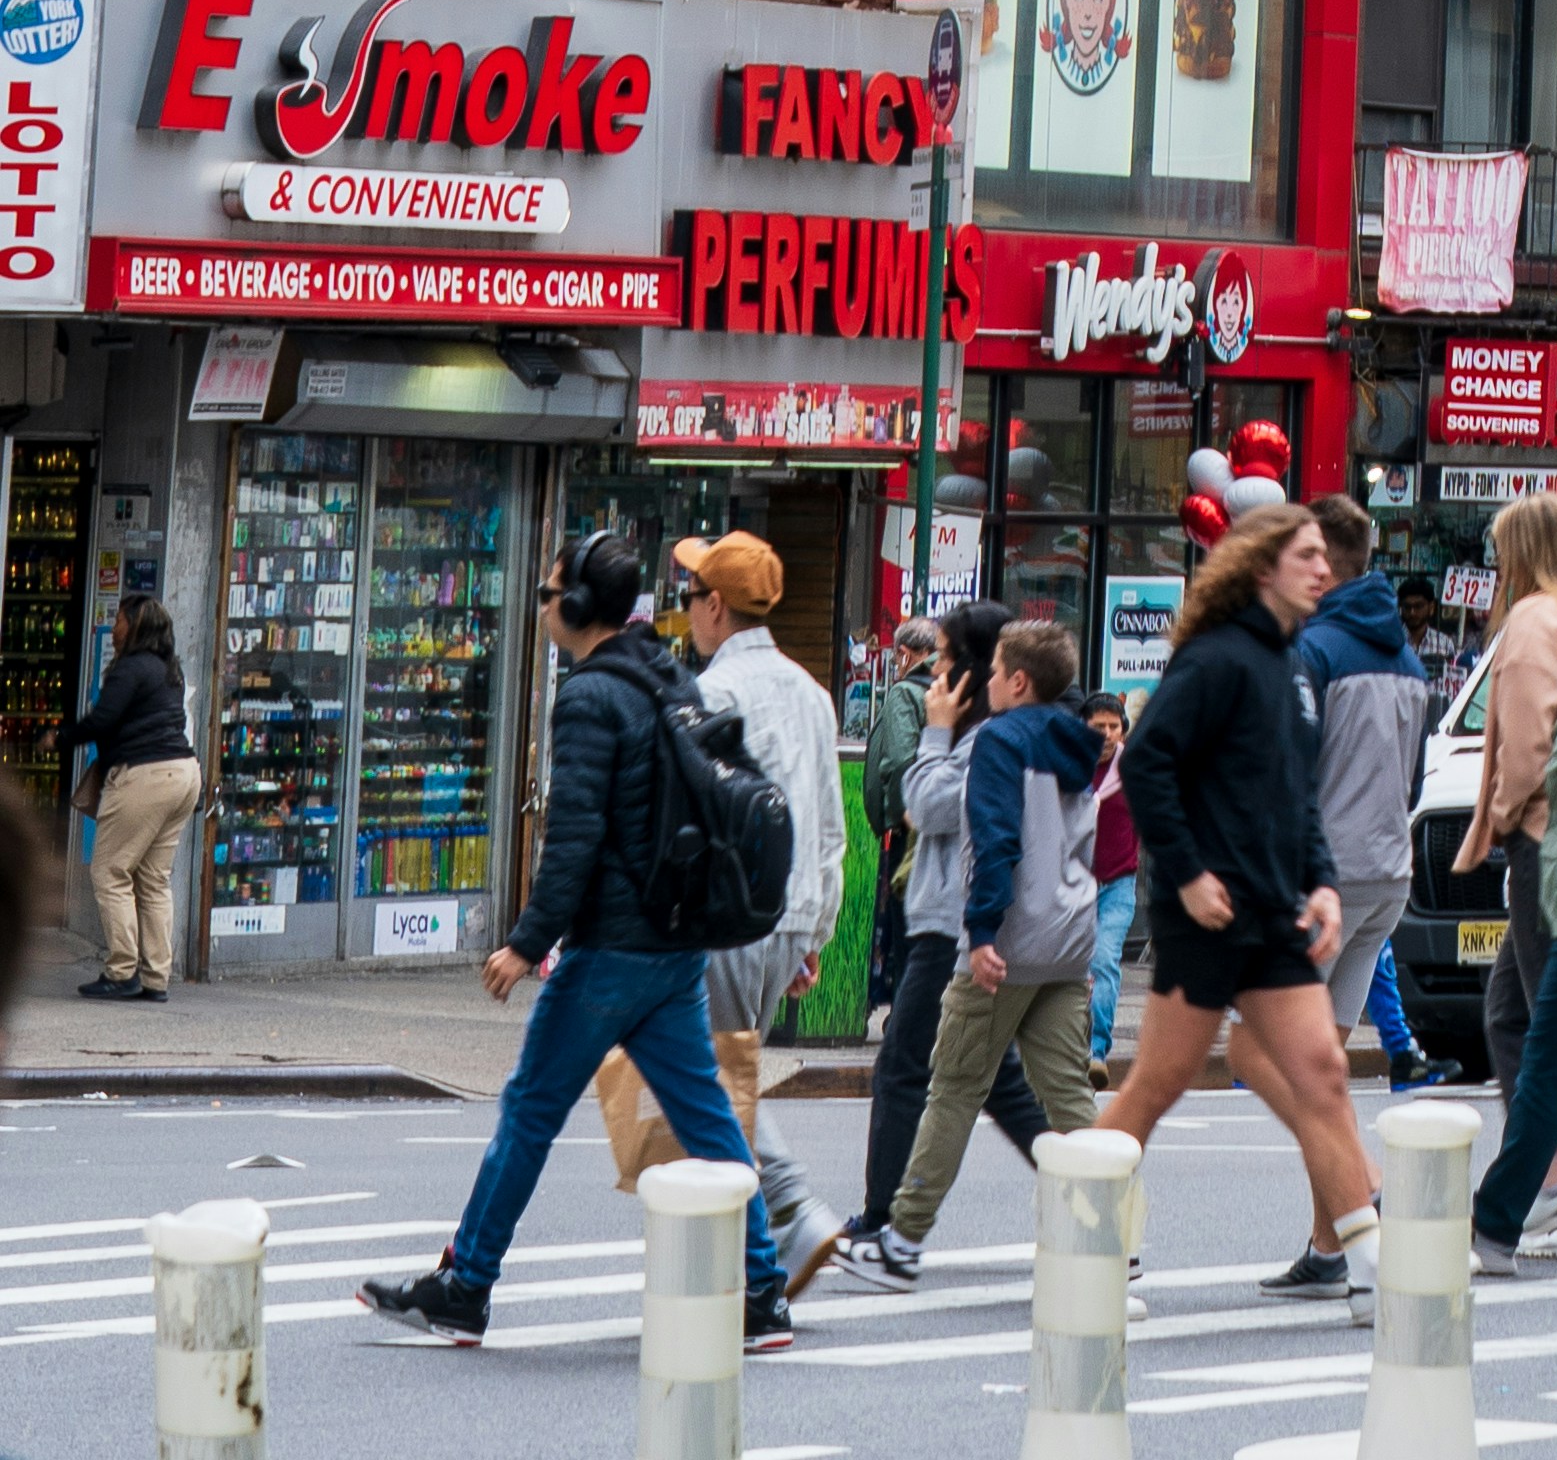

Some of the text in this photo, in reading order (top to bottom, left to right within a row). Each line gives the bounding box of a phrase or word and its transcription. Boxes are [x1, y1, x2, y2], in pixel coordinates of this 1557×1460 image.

[3, 16, 80, 56] LOTTERY
[0, 81, 63, 281] LOTTO
[1393, 154, 1521, 229] TATTOO
[269, 173, 544, 224] & CONVENIENCE
[130, 256, 181, 295] BEER
[201, 257, 311, 300] BEVERAGE
[328, 263, 395, 302] LOTTO
[412, 265, 462, 302] VAPE
[493, 268, 529, 305] CIG
[544, 271, 604, 308] CIGAR
[621, 274, 660, 310] PIPE
[1054, 242, 1196, 364] Wendy's
[1452, 346, 1545, 373] MONEY
[1451, 376, 1542, 400] CHANGE
[638, 405, 706, 436] 70% OFF
[787, 411, 833, 445] SALE
[1447, 414, 1540, 435] SOUVENIRS
[1444, 472, 1470, 498] NYPD
[1474, 473, 1499, 499] FDNY
[1113, 612, 1175, 633] CINNABON
[392, 911, 429, 937] Lyca
